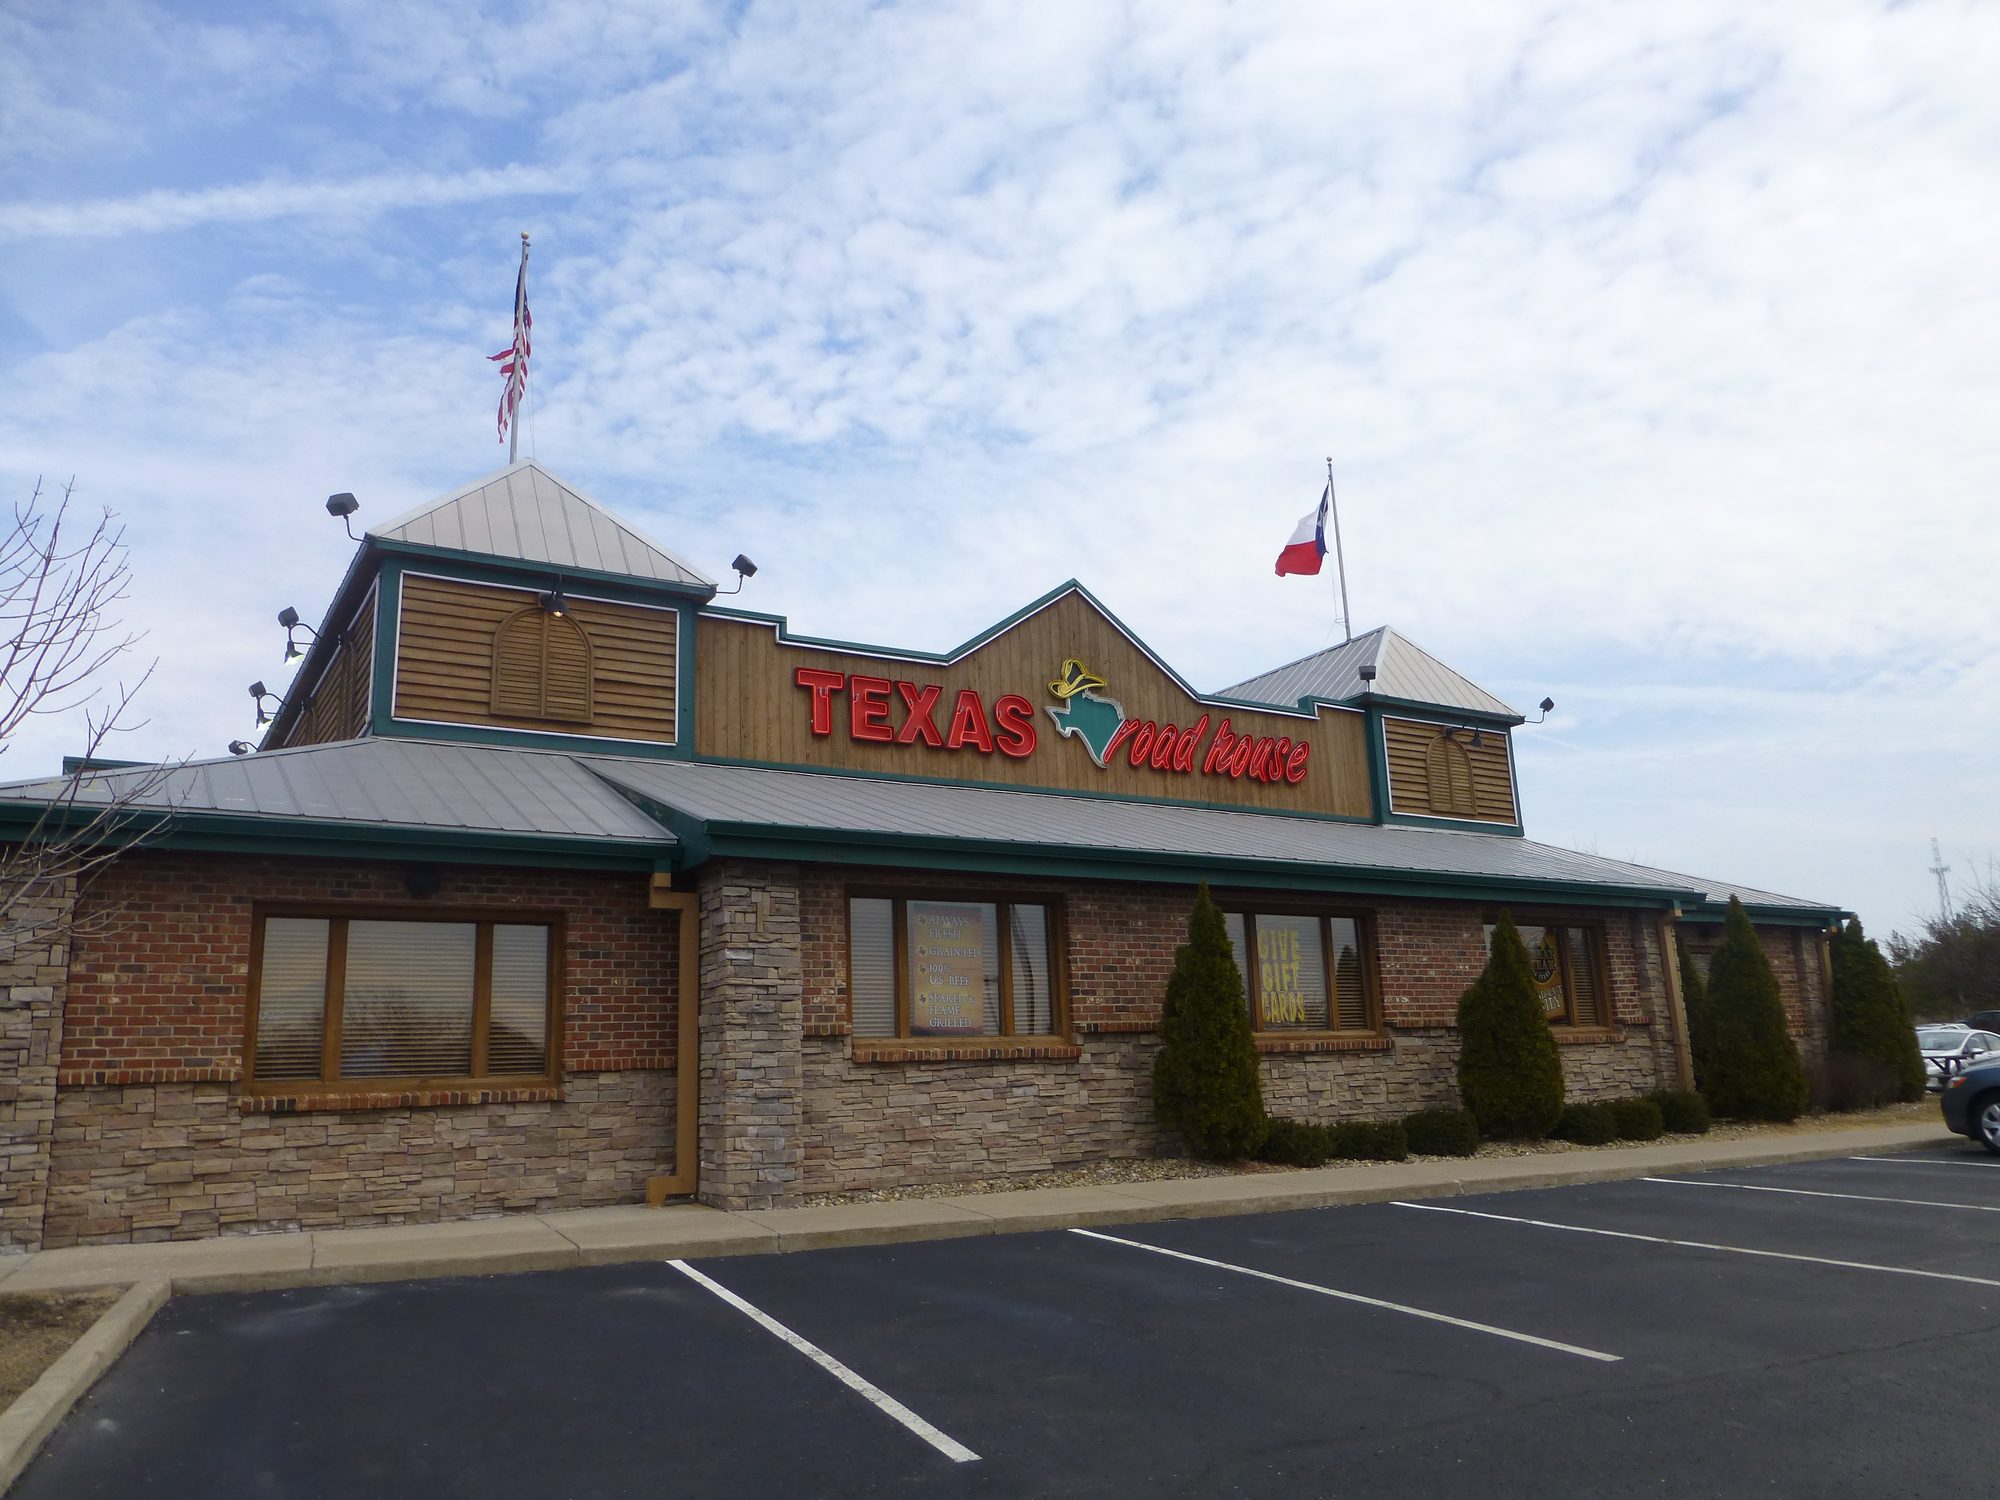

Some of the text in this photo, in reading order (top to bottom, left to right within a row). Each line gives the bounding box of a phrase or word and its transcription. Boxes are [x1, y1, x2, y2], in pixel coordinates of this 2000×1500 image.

[794, 667, 1038, 759] TEXAS
[929, 915, 970, 926] ALWAYS
[929, 928, 961, 939] FRESH
[1257, 927, 1300, 961] GIVE
[949, 975, 971, 986] BEEF
[1262, 960, 1300, 992] GIFT
[929, 992, 966, 1003] SEARED
[929, 1006, 962, 1015] FLAME
[1262, 991, 1306, 1024] CARDS
[929, 1018, 973, 1028] GRILLED
